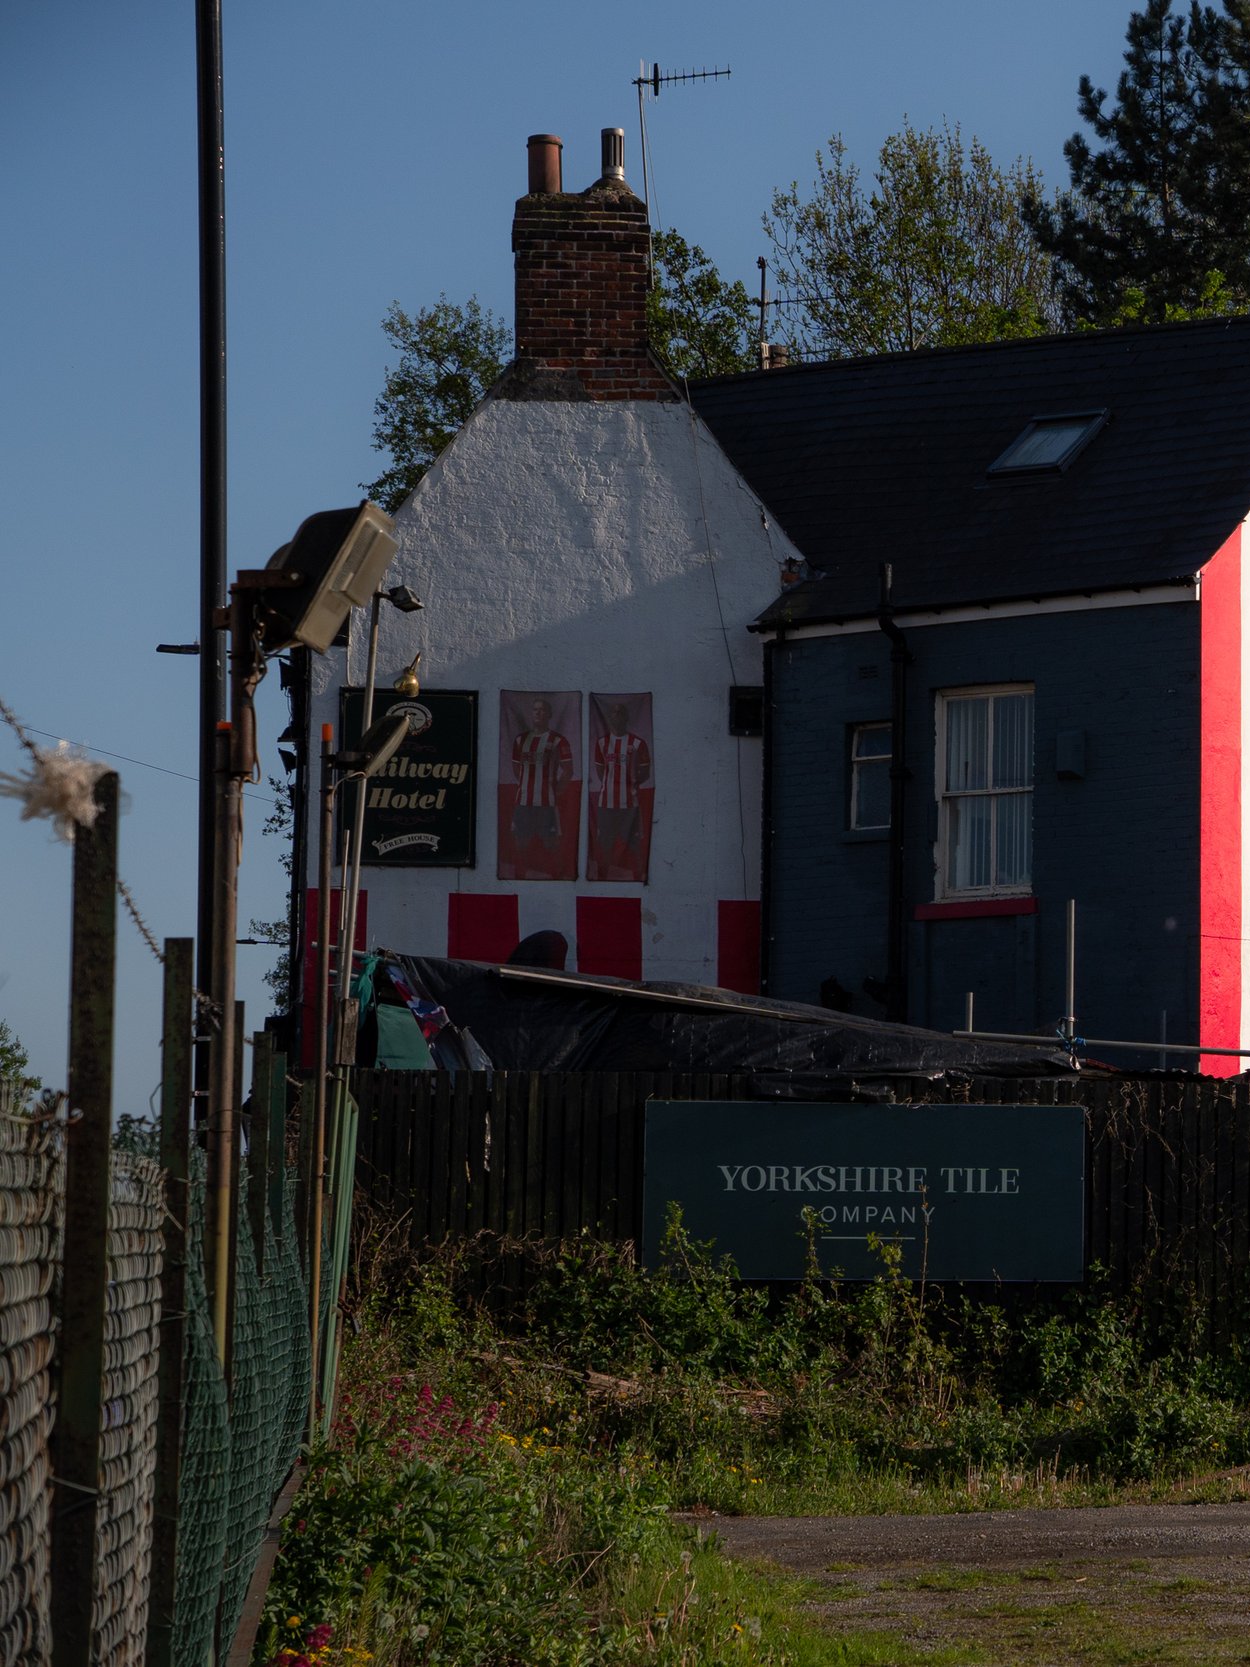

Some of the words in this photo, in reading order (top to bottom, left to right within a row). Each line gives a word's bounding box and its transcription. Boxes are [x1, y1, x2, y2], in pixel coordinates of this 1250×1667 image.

[367, 787, 447, 810] Hotel
[384, 838, 405, 850] FREE
[407, 835, 435, 844] HOUSE
[716, 1164, 928, 1194] YORKSHIRE
[940, 1167, 1020, 1194] TILE
